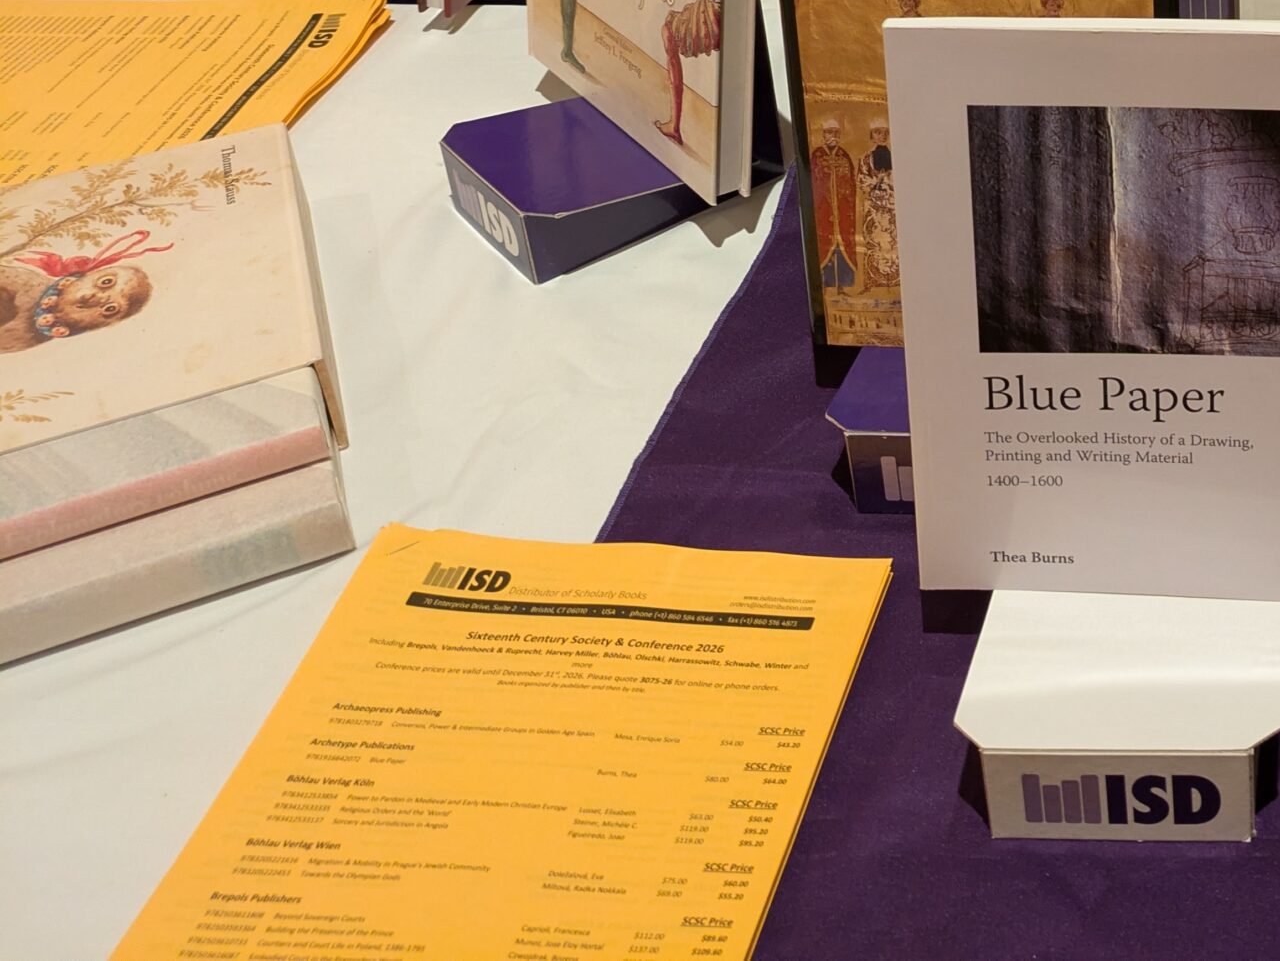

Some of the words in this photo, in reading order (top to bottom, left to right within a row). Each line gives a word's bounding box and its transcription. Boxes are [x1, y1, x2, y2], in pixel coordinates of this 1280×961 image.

[221, 145, 236, 178] Thomas
[477, 190, 519, 257] ISD
[983, 375, 1081, 411] Blue
[1098, 376, 1224, 422] Paper
[990, 551, 1027, 563] Thea
[1031, 552, 1074, 564] Burns
[457, 567, 511, 592] ISD
[466, 631, 520, 642] Sixteenth
[523, 634, 569, 644] Century
[572, 636, 612, 647] Society
[615, 638, 623, 646] &
[628, 638, 693, 652] Conference
[696, 643, 725, 653] 2026
[333, 703, 393, 714] Archaeopress
[396, 707, 442, 717] Publishing
[759, 727, 781, 735] SCSC
[784, 728, 805, 736] Price
[310, 738, 357, 749] Archetype
[360, 741, 415, 751] Publications
[1105, 775, 1221, 825] ISD
